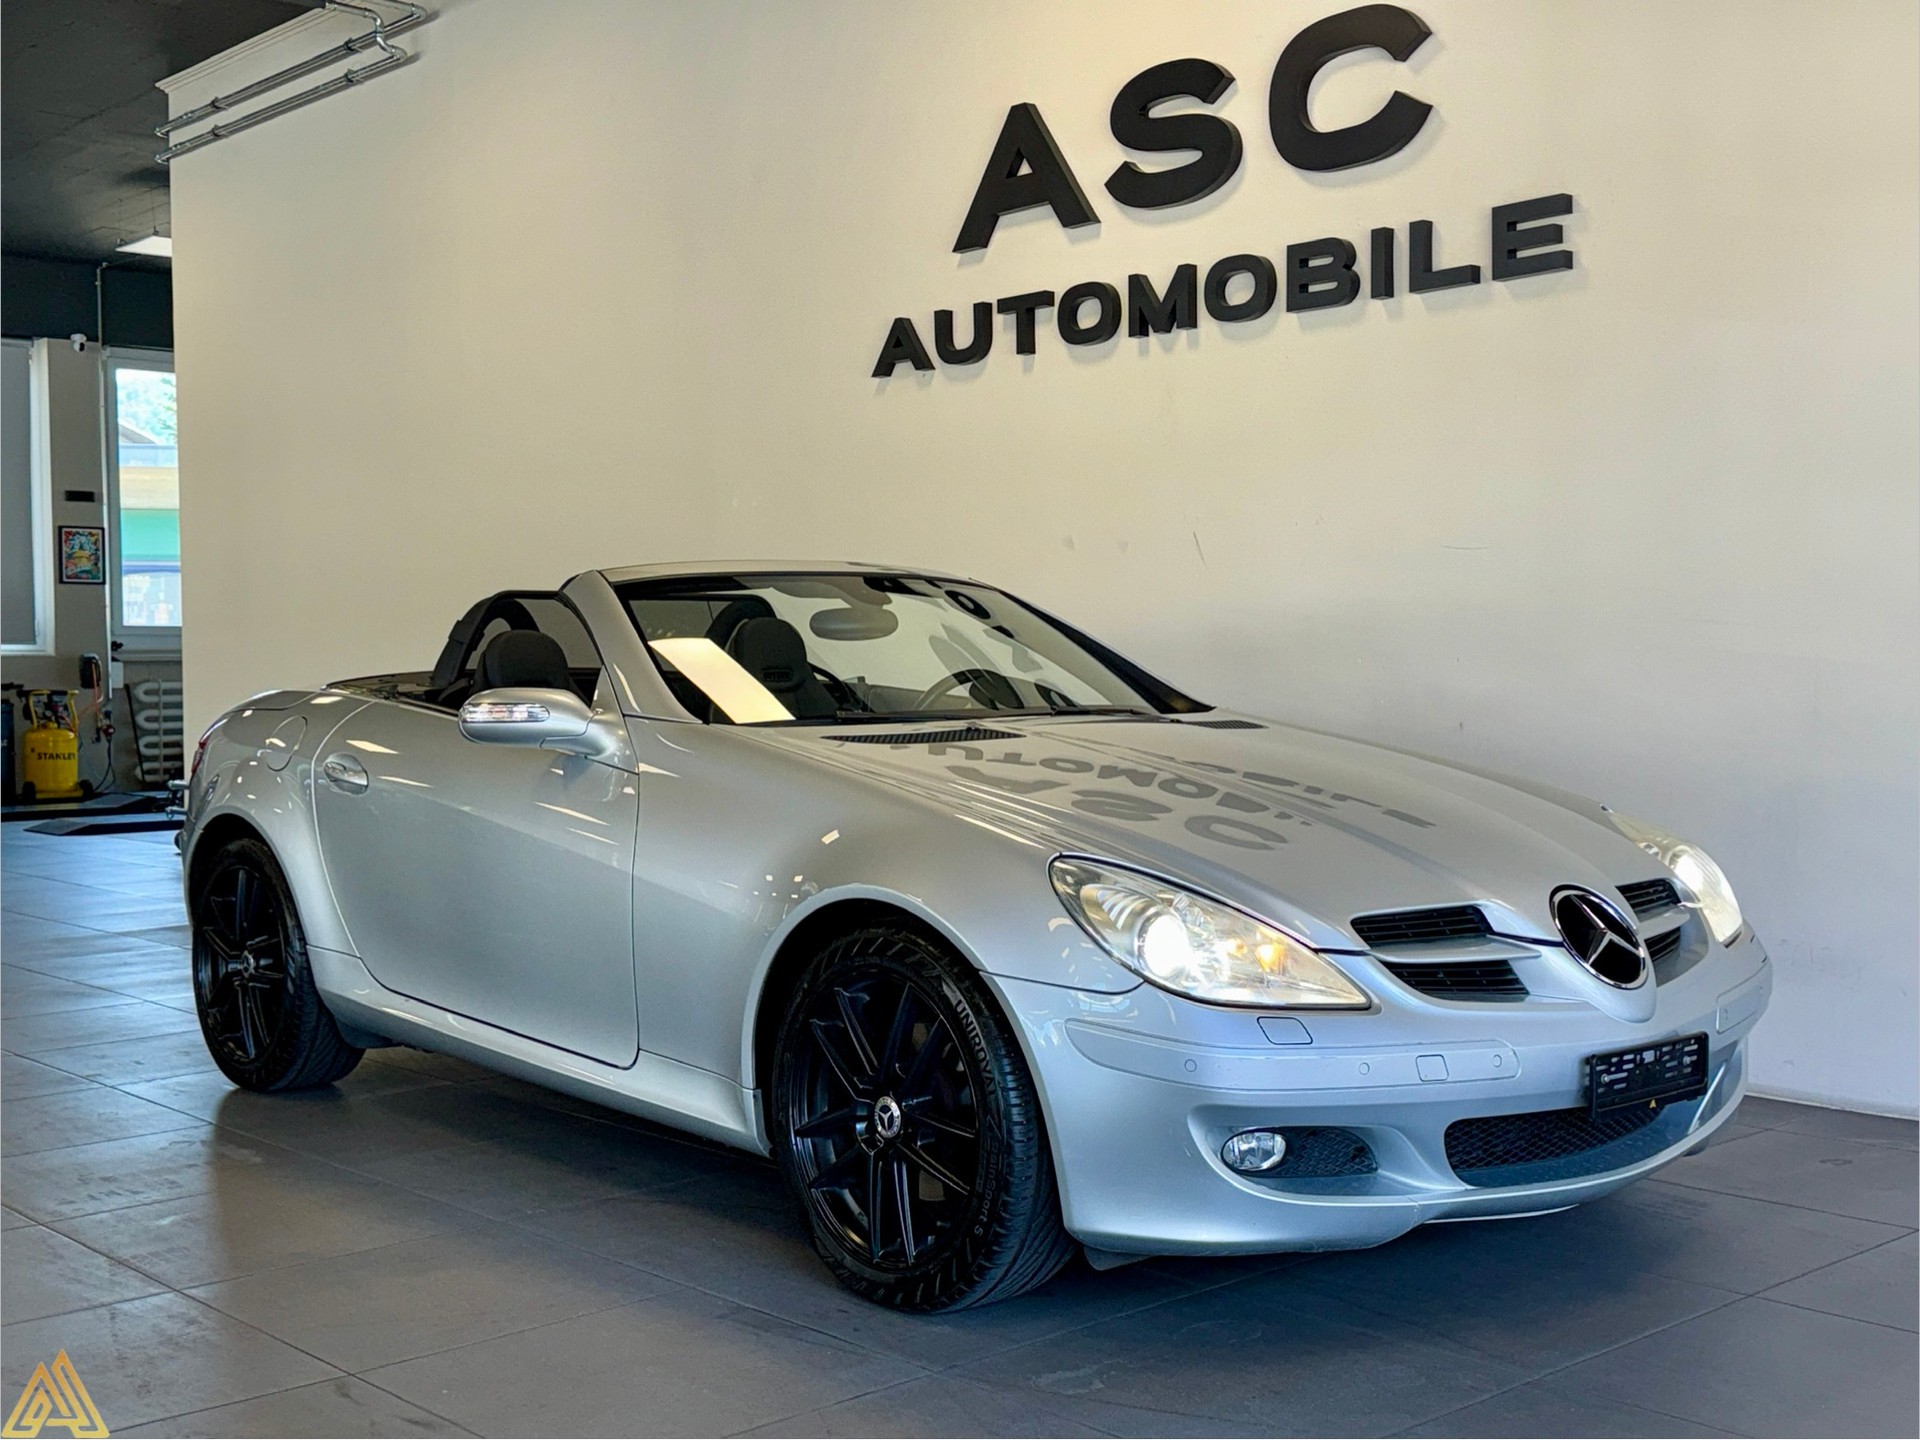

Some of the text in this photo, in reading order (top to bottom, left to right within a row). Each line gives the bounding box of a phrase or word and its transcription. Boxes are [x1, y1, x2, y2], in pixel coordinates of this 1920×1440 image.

[952, 3, 1434, 253] ASC
[871, 193, 1573, 378] AUTOMOBILE
[955, 999, 996, 1096] UNIROYAL
